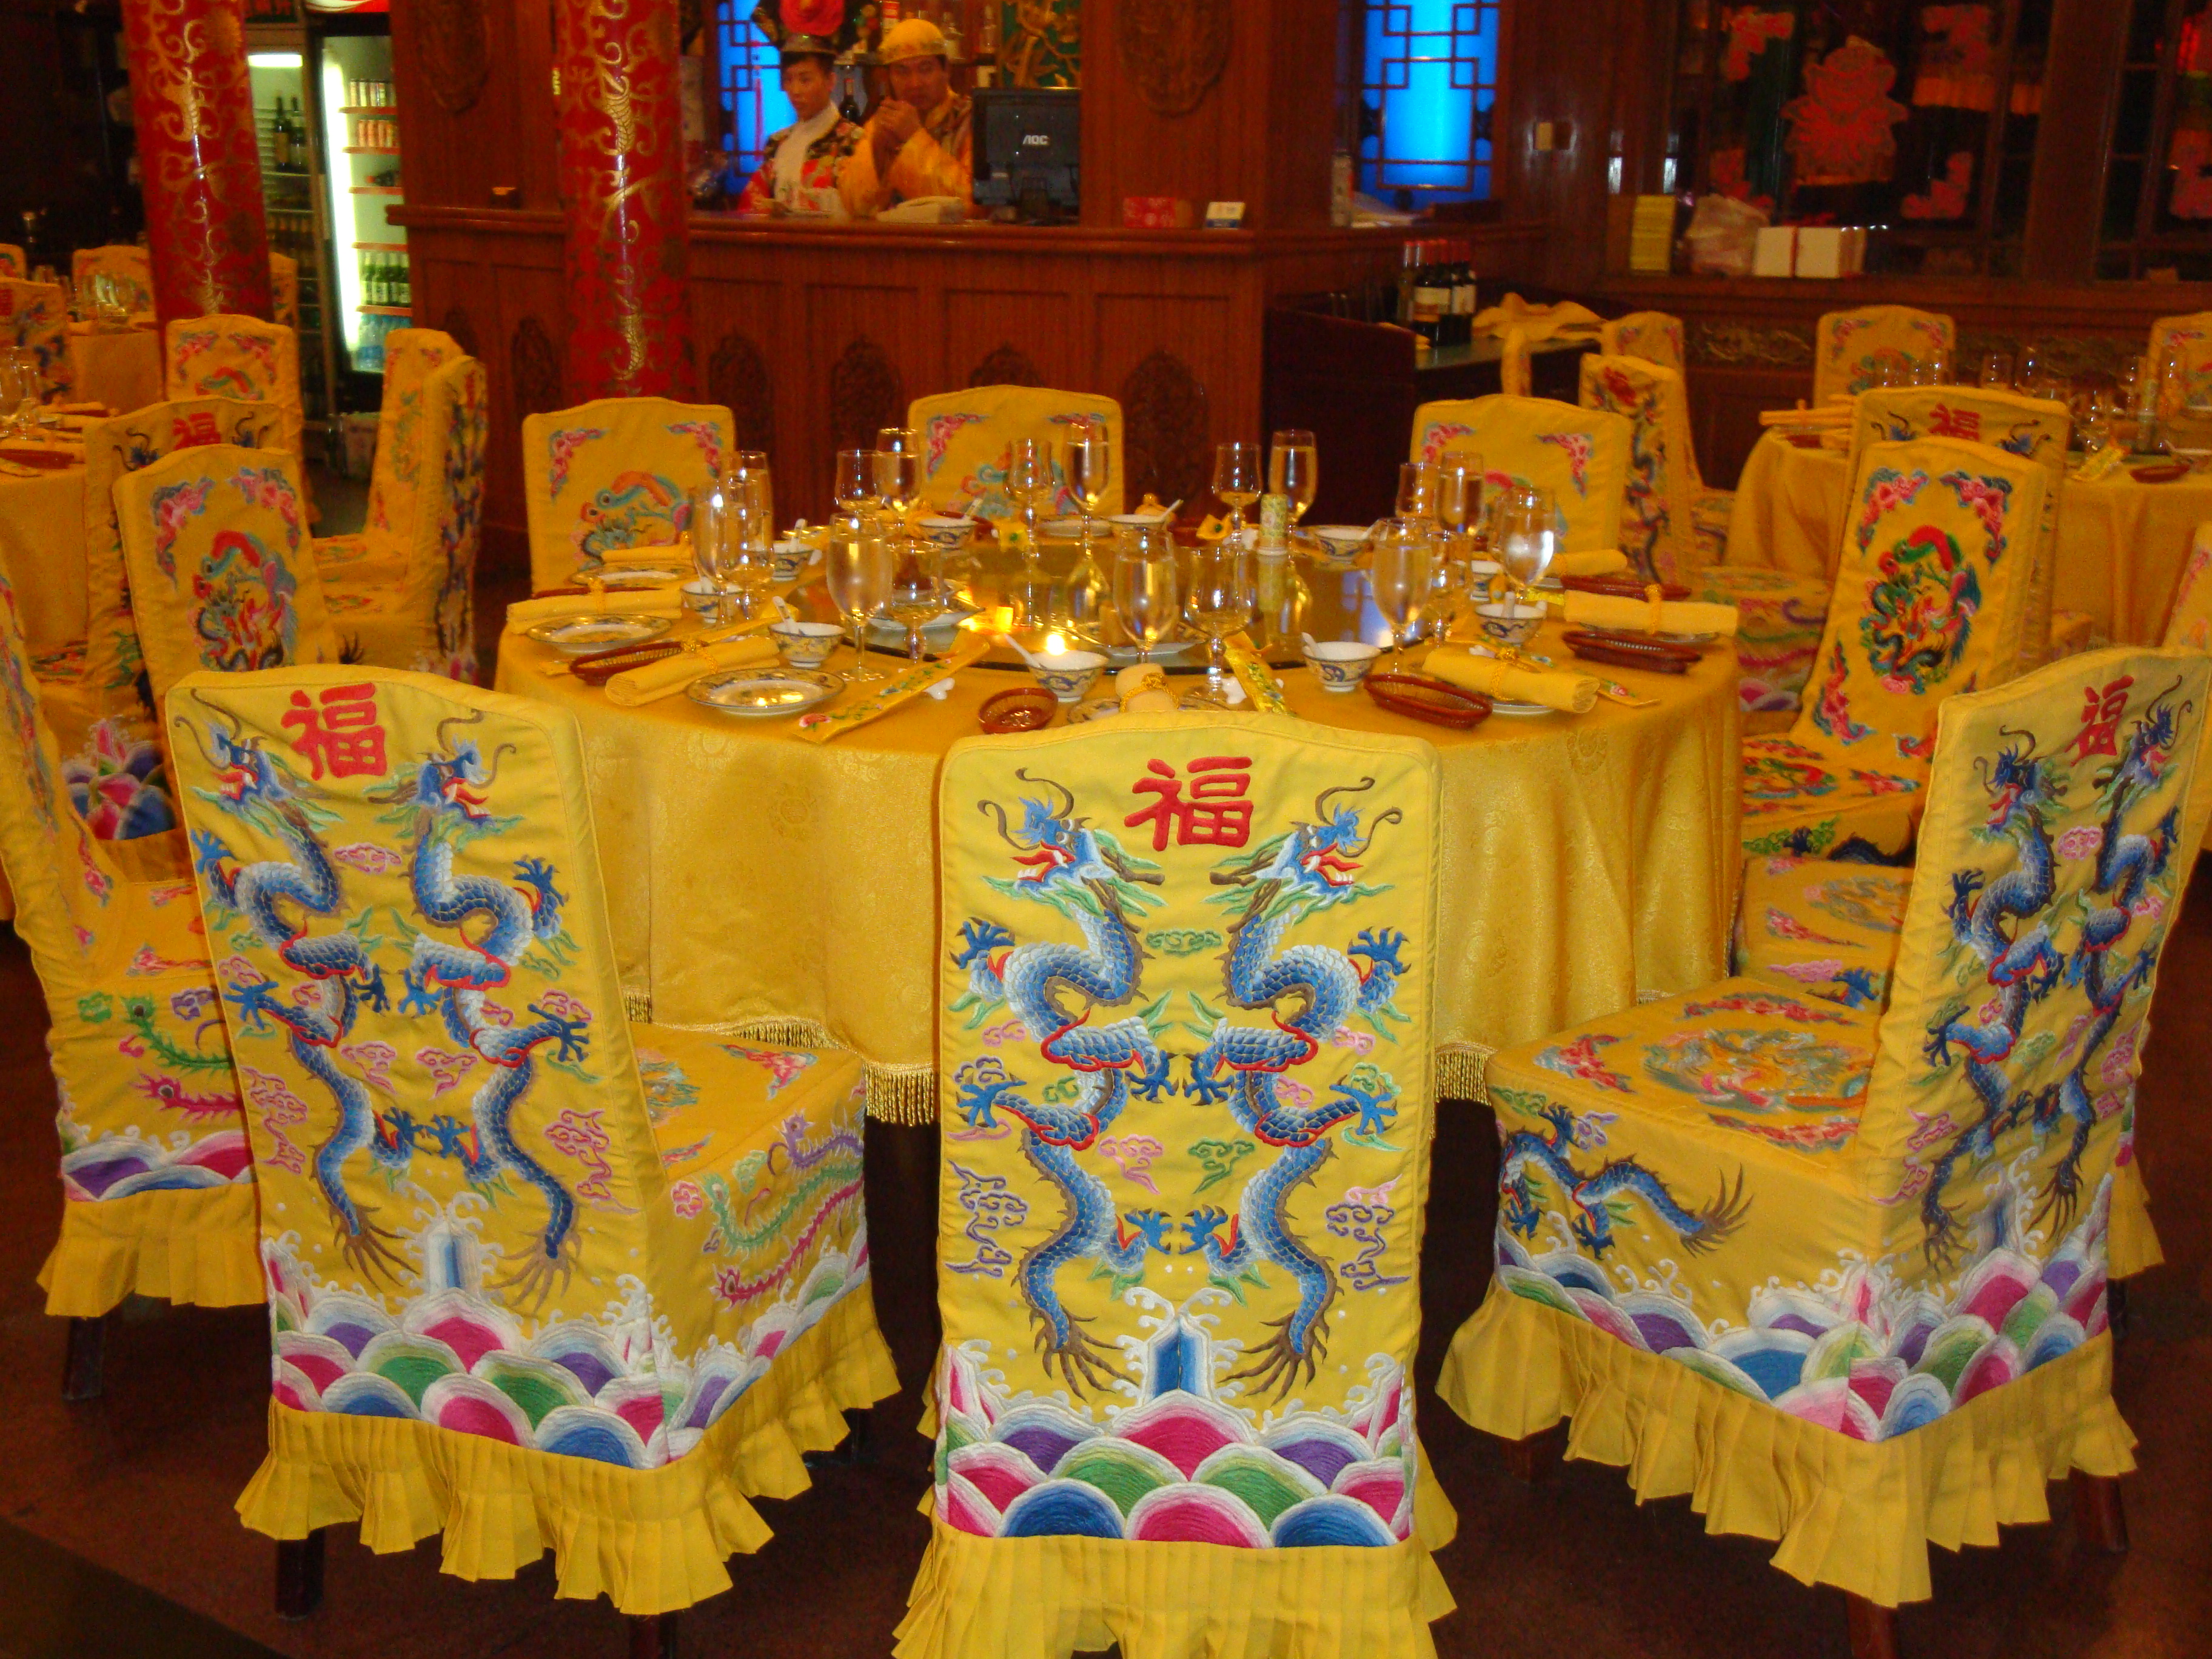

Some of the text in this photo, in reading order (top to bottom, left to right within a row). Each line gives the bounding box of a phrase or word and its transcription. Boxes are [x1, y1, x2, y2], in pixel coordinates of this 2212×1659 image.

[1022, 135, 1049, 145] AOC
[1929, 403, 1980, 442] 福
[281, 683, 387, 781] 福
[2065, 675, 2134, 767] 福
[1124, 756, 1254, 851] 福
